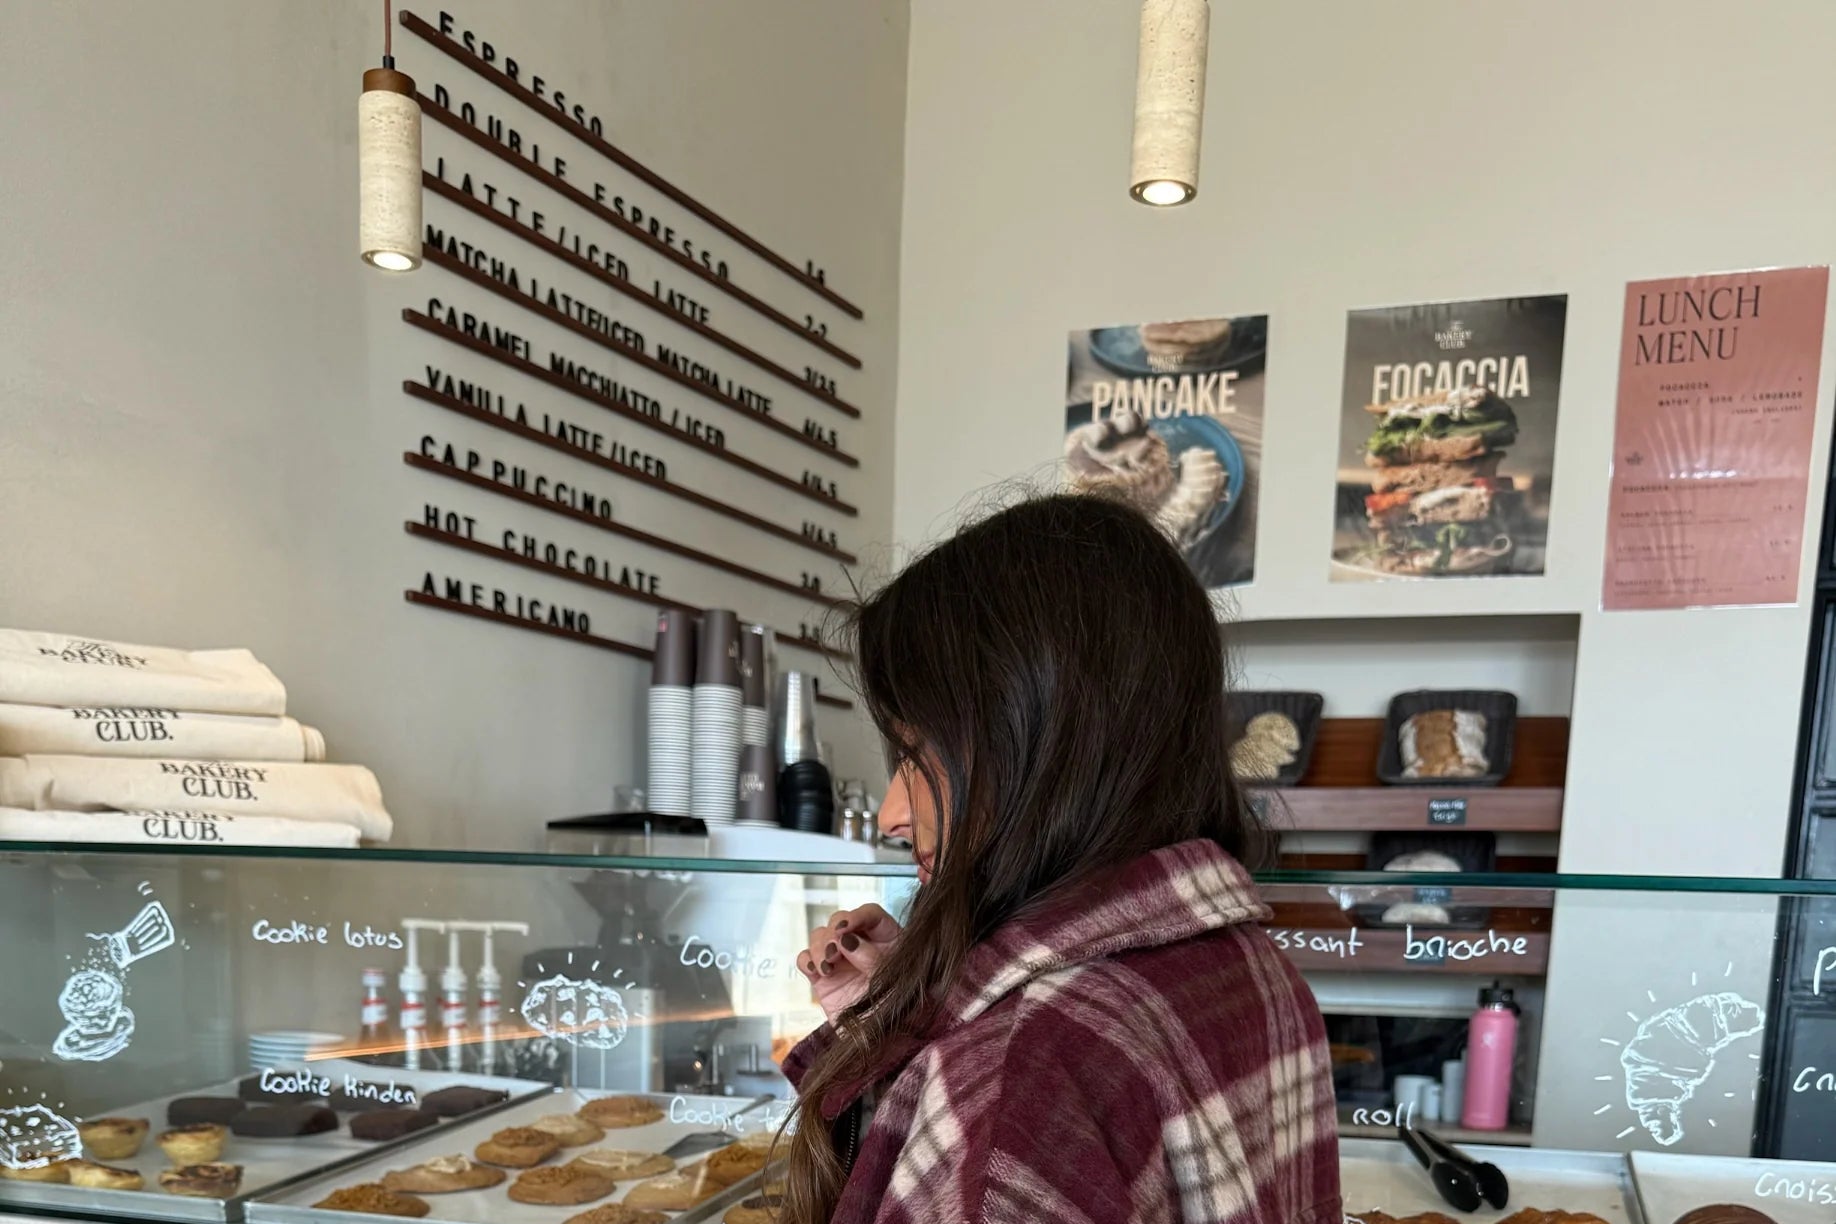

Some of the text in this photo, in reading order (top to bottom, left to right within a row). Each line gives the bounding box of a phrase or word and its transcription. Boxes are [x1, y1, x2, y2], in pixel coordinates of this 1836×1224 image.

[439, 11, 602, 138] ESPRESSO
[435, 84, 729, 282] DOUBLE ESPRESSO
[427, 224, 520, 291] MATCHA
[657, 344, 720, 394] MATCHA
[727, 380, 772, 415] LATTE
[653, 280, 711, 325] LATTE
[1637, 285, 1761, 327] LUNCH
[428, 298, 531, 361] CARAMEL
[550, 352, 661, 420] MACCHIATTO
[1634, 326, 1739, 367] MENU
[426, 365, 528, 427] VANILLA
[1091, 370, 1240, 424] PANCAKE
[1371, 355, 1531, 406] FOCACCIA
[420, 435, 612, 520] CAPPUCCINO
[424, 504, 661, 596] HOT CHOCOLATE
[422, 572, 590, 634] AMERICANO
[96, 720, 174, 742] CLUB.
[160, 761, 268, 783] BAKERY
[182, 777, 259, 801] CLUB.
[143, 818, 224, 842] CLUB.
[252, 919, 329, 945] Cookie
[260, 1066, 331, 1097] Cookie
[669, 1095, 745, 1131] Cookie
